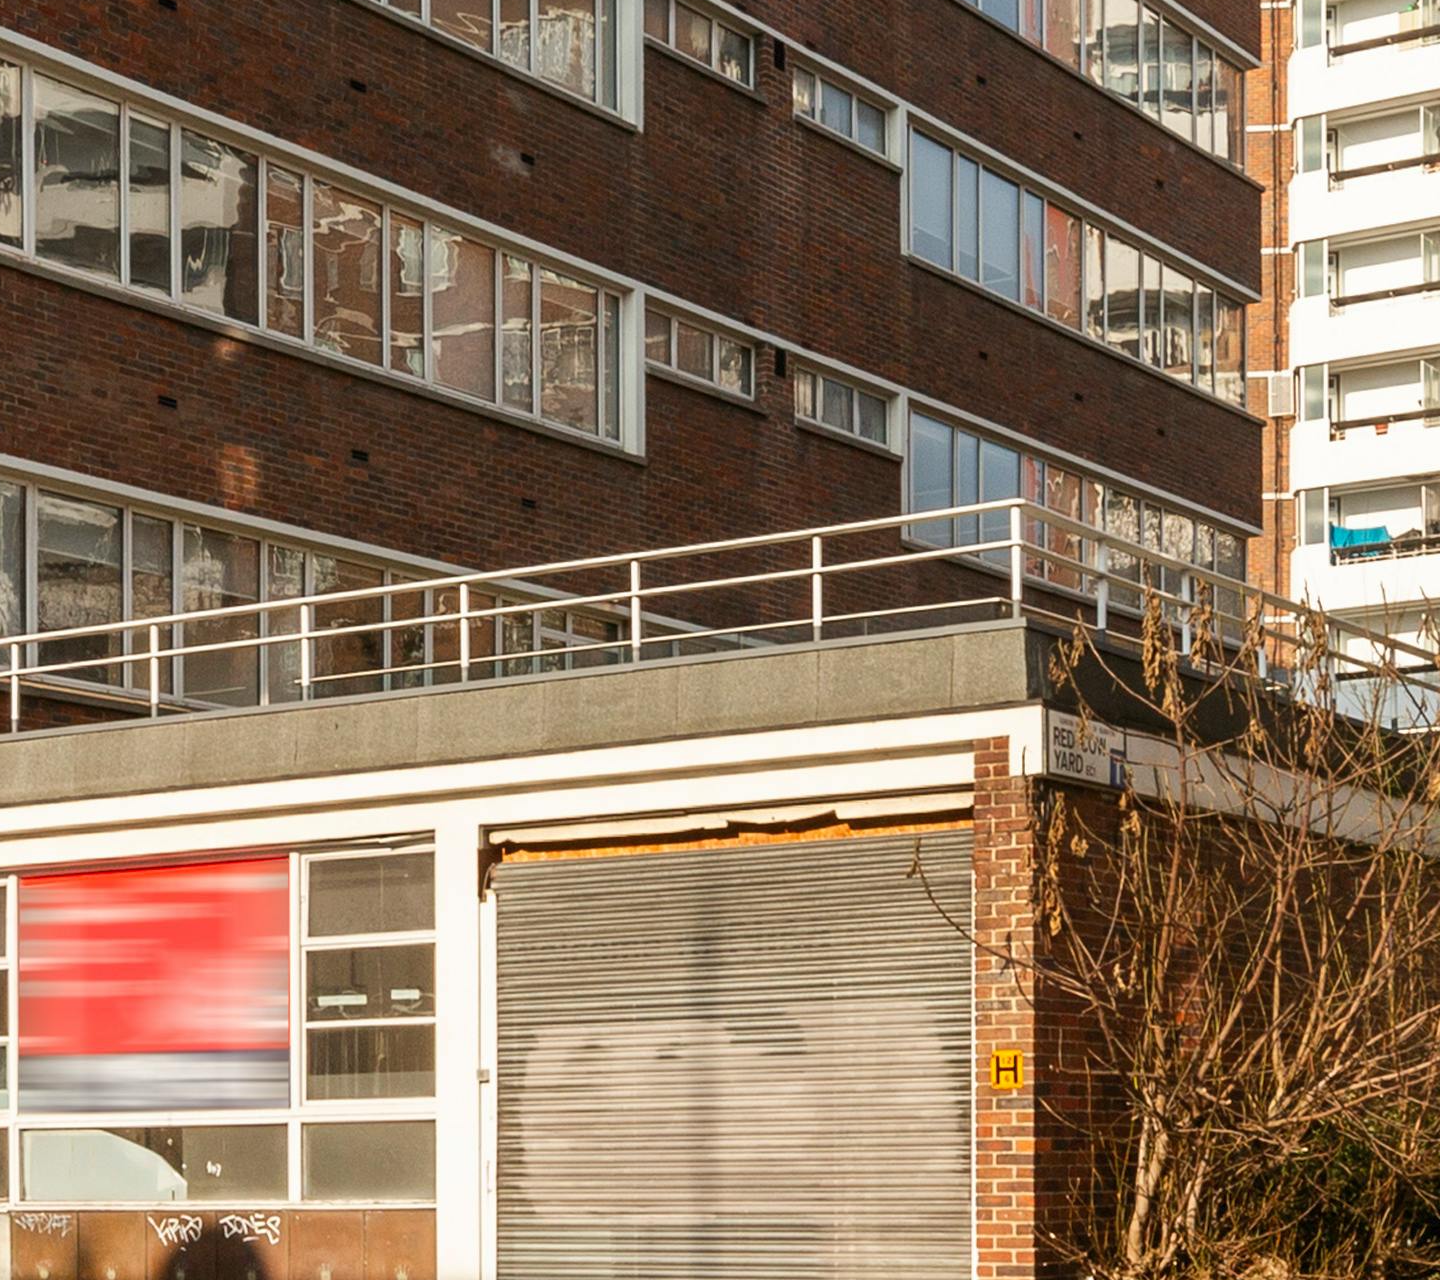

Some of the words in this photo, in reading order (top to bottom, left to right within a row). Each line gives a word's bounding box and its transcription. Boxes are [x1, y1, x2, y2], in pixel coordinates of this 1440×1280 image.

[1053, 726, 1075, 749] RED
[1054, 749, 1084, 774] YARD
[996, 1055, 1018, 1085] H
